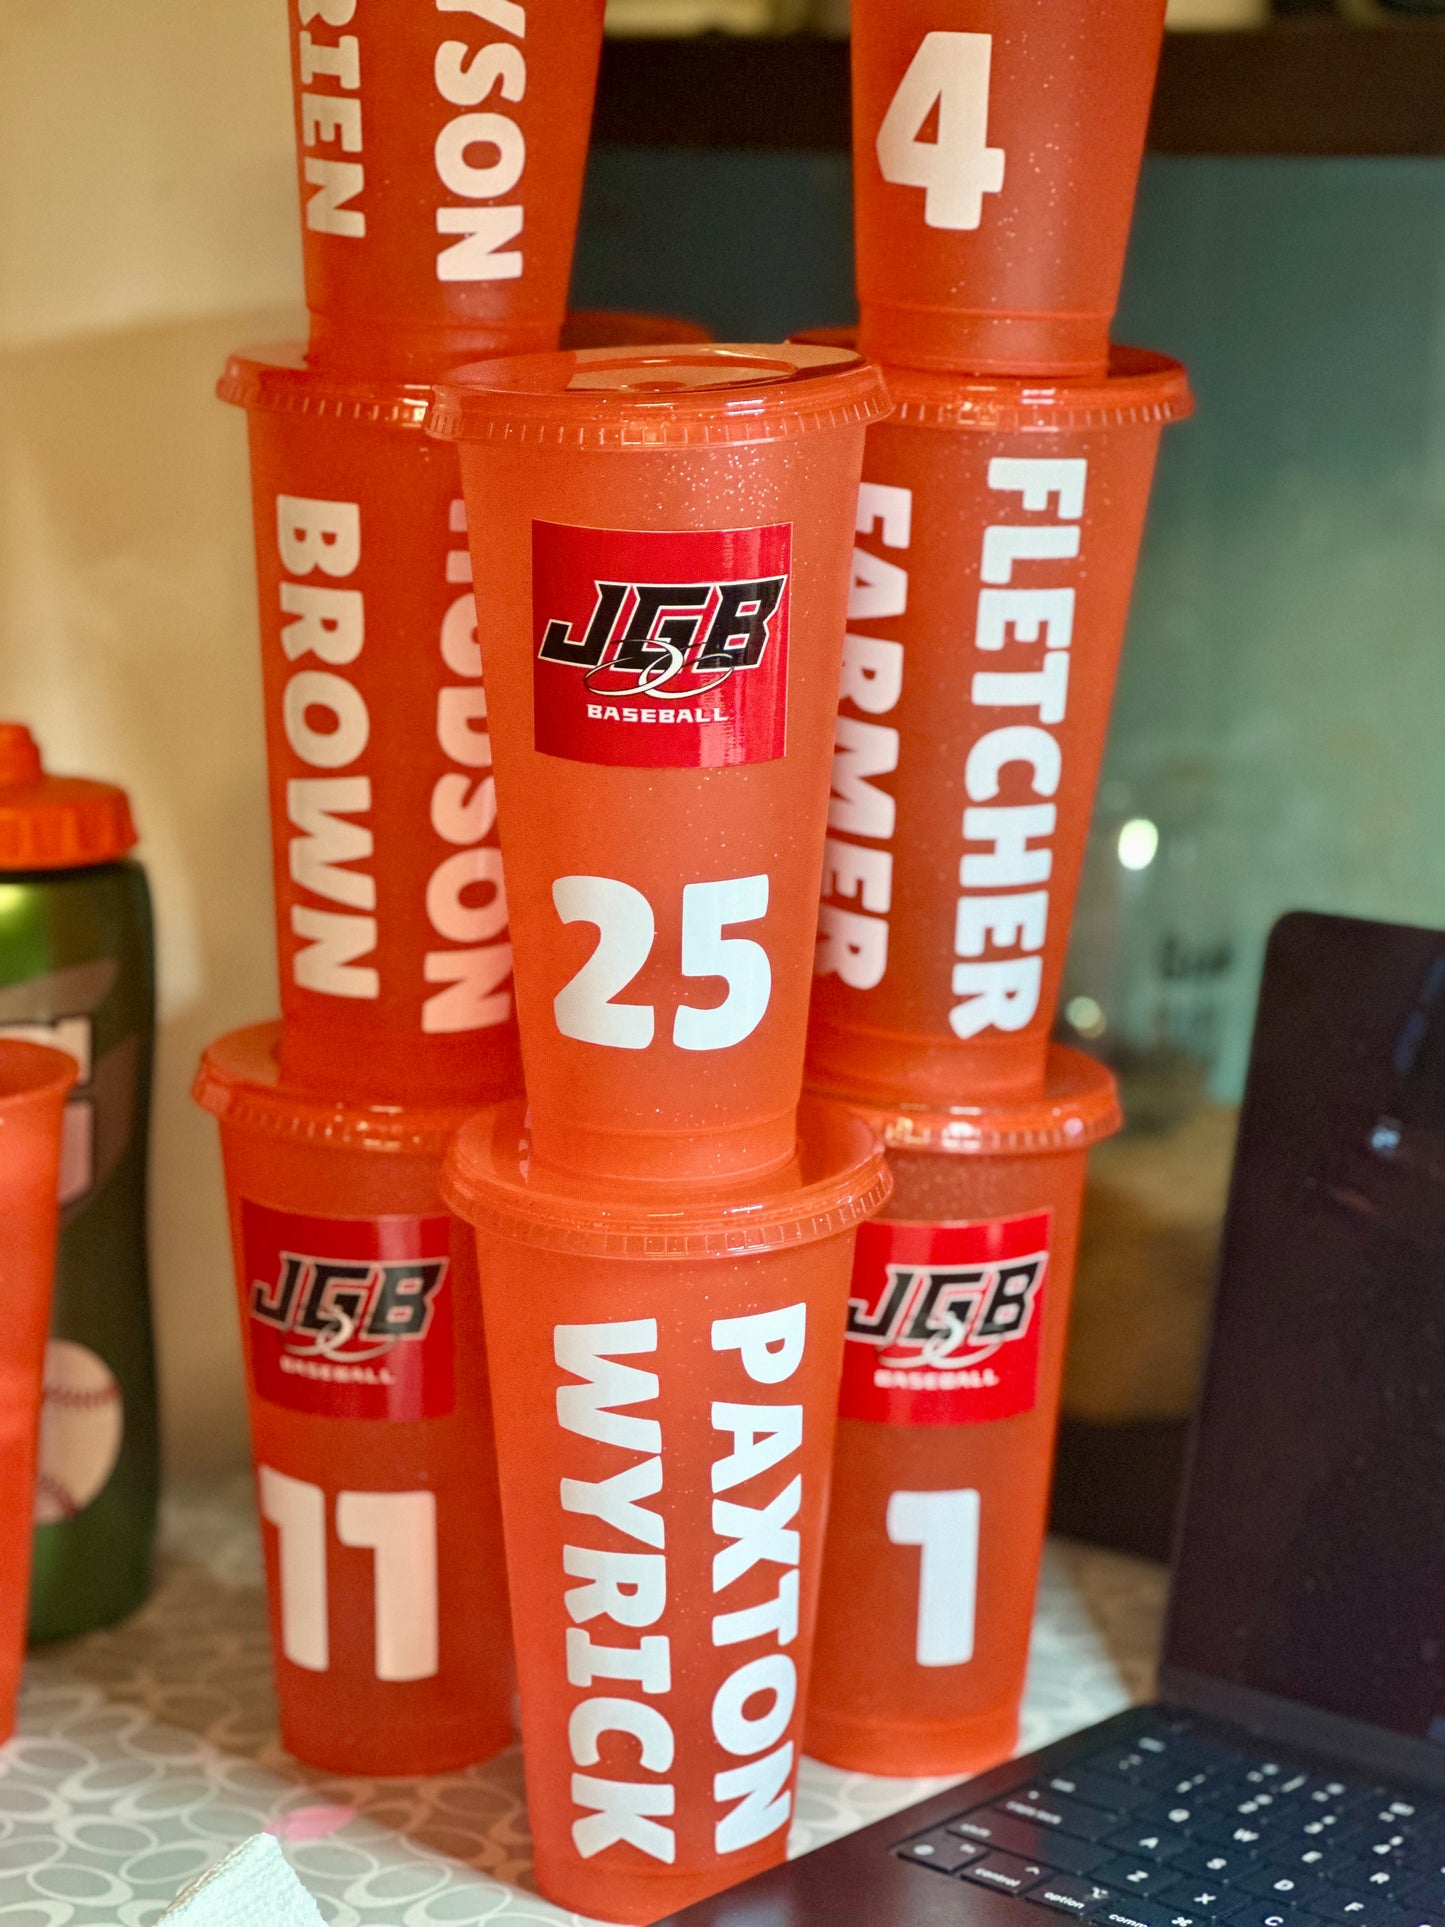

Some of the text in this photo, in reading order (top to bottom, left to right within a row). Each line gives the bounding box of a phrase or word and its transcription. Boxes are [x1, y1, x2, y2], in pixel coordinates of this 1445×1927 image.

[876, 30, 1005, 230] 4
[537, 573, 789, 674] JGB
[586, 703, 729, 724] BASEBALL
[276, 495, 379, 998] BROWN
[421, 499, 512, 1034] DSON
[813, 482, 912, 990] FARMER
[949, 457, 1087, 1040] FLETCHER
[552, 873, 772, 1051] 25
[250, 1250, 449, 1342] JGB
[259, 1464, 439, 1681] 11
[553, 1318, 676, 1865] WYRICK
[711, 1302, 807, 1855] PAXTON
[887, 1489, 980, 1668] 1
[1043, 1892, 1085, 1909] option
[1264, 1915, 1285, 1927] C
